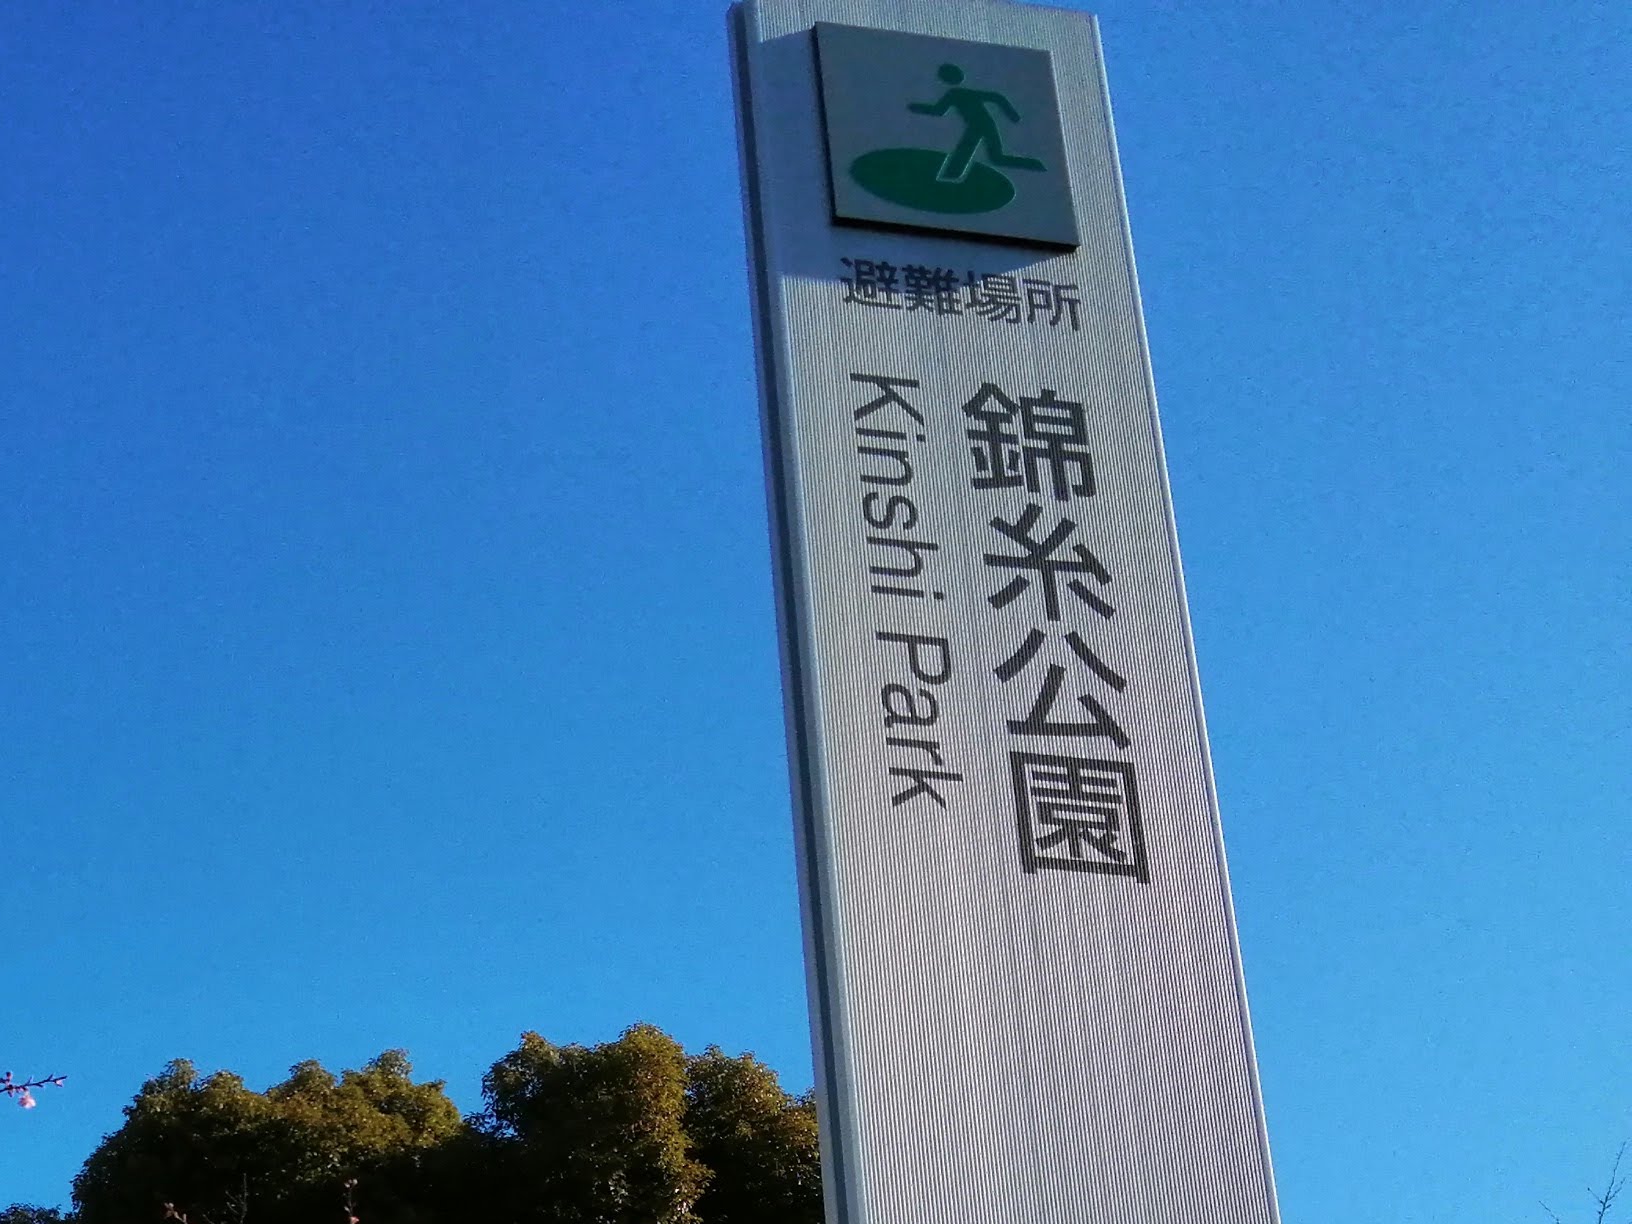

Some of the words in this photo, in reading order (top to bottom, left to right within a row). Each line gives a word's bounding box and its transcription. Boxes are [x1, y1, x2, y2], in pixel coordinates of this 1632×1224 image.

[839, 256, 1081, 332] 避難場所
[848, 372, 945, 601] Kinshi
[875, 631, 965, 811] Park
[961, 380, 1151, 886] 錦糸公園
